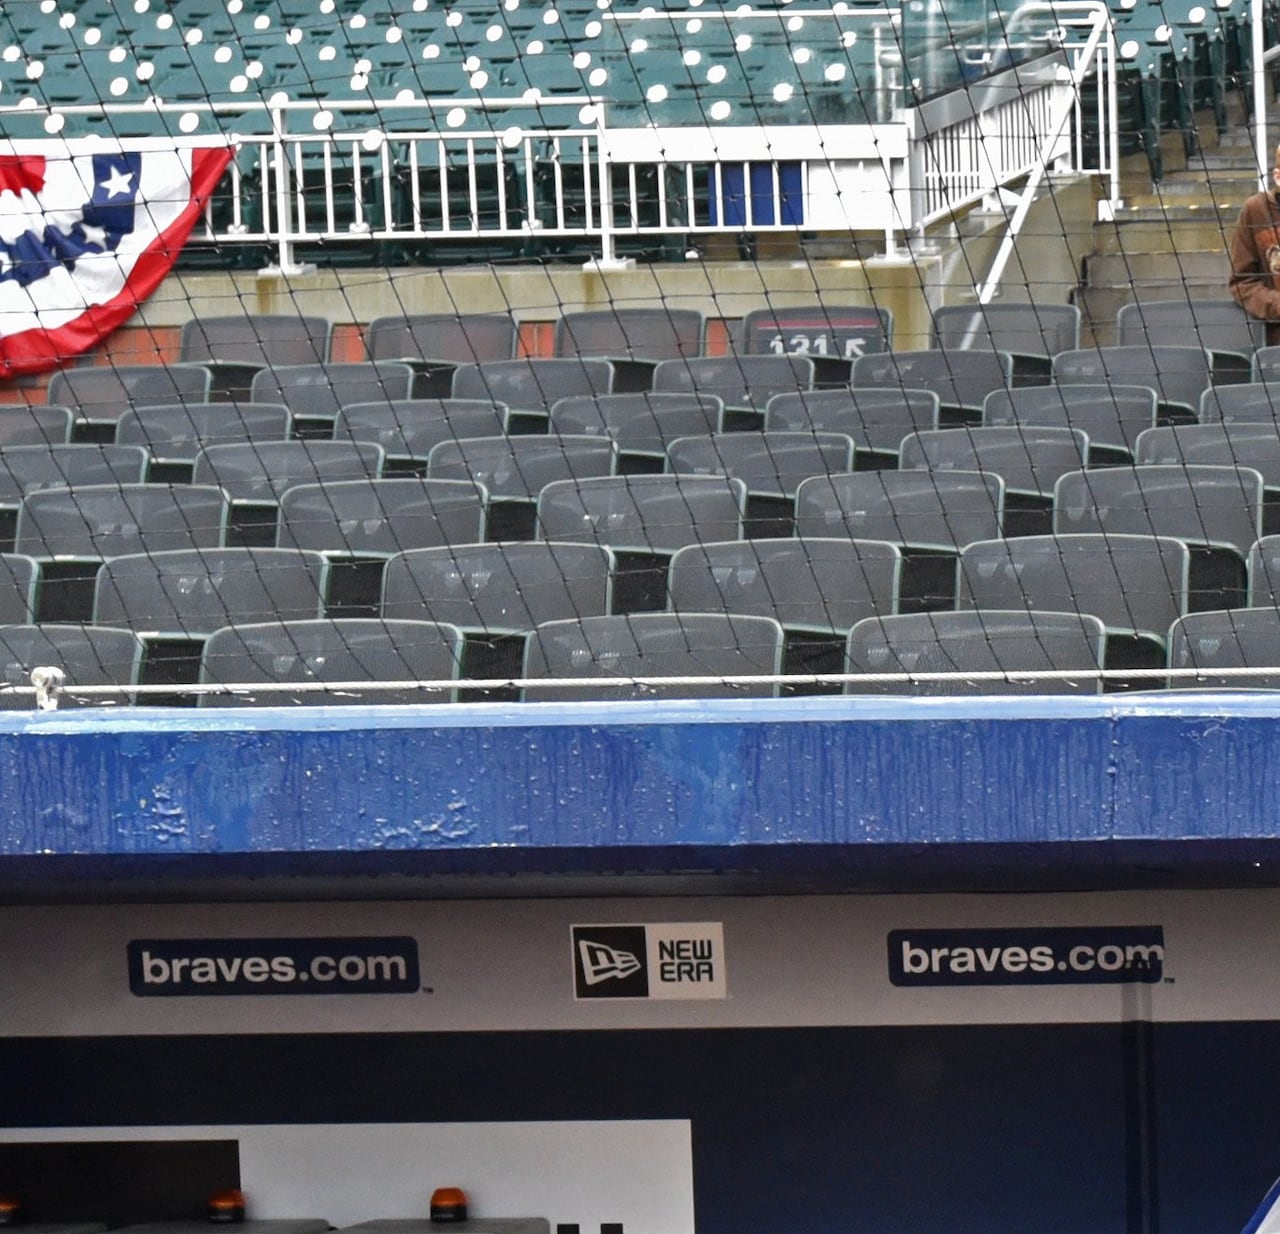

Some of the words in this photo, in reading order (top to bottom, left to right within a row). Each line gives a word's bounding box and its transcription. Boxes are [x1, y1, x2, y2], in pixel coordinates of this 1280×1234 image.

[659, 940, 713, 961] NEW
[902, 940, 1164, 973] braves.com
[142, 951, 407, 984] braves.com
[661, 963, 714, 983] ERA
